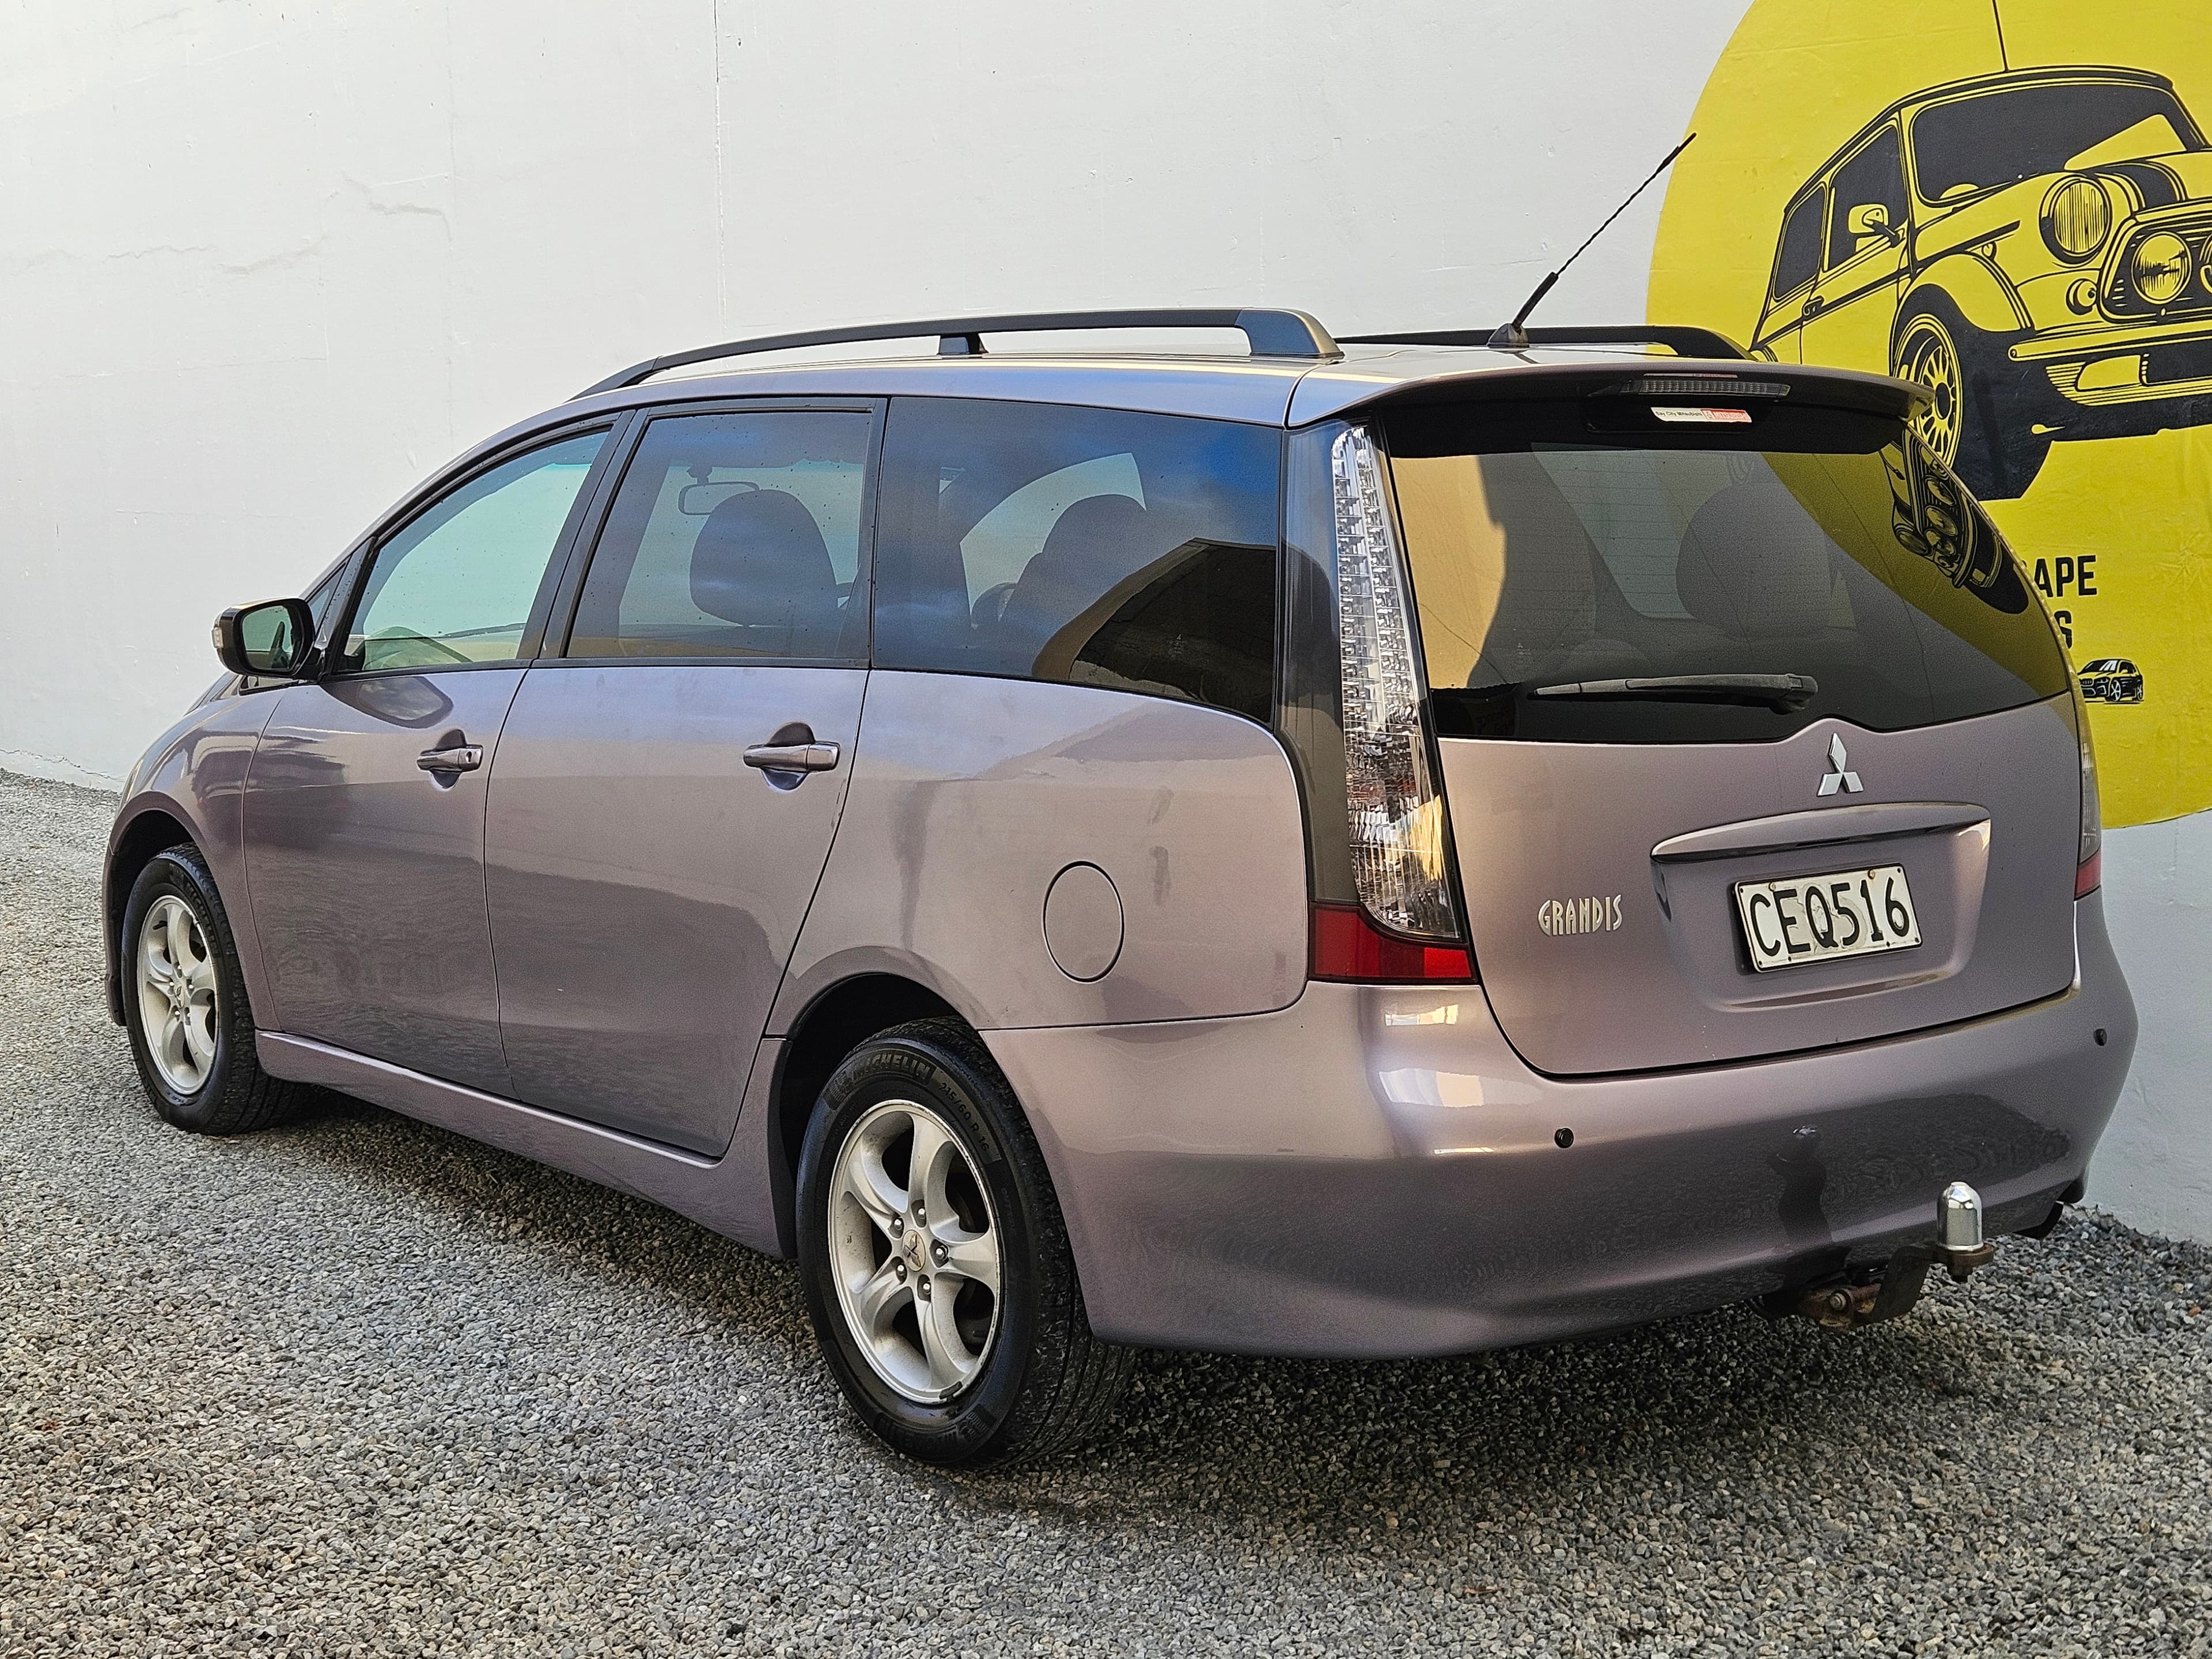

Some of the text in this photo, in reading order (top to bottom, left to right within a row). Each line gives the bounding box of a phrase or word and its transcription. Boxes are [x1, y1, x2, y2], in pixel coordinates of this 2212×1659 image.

[2021, 555, 2097, 597] APE
[1538, 894, 1622, 936] GRANDIS
[1749, 876, 1910, 957] CEQ516
[852, 1053, 931, 1081] MICHELIN
